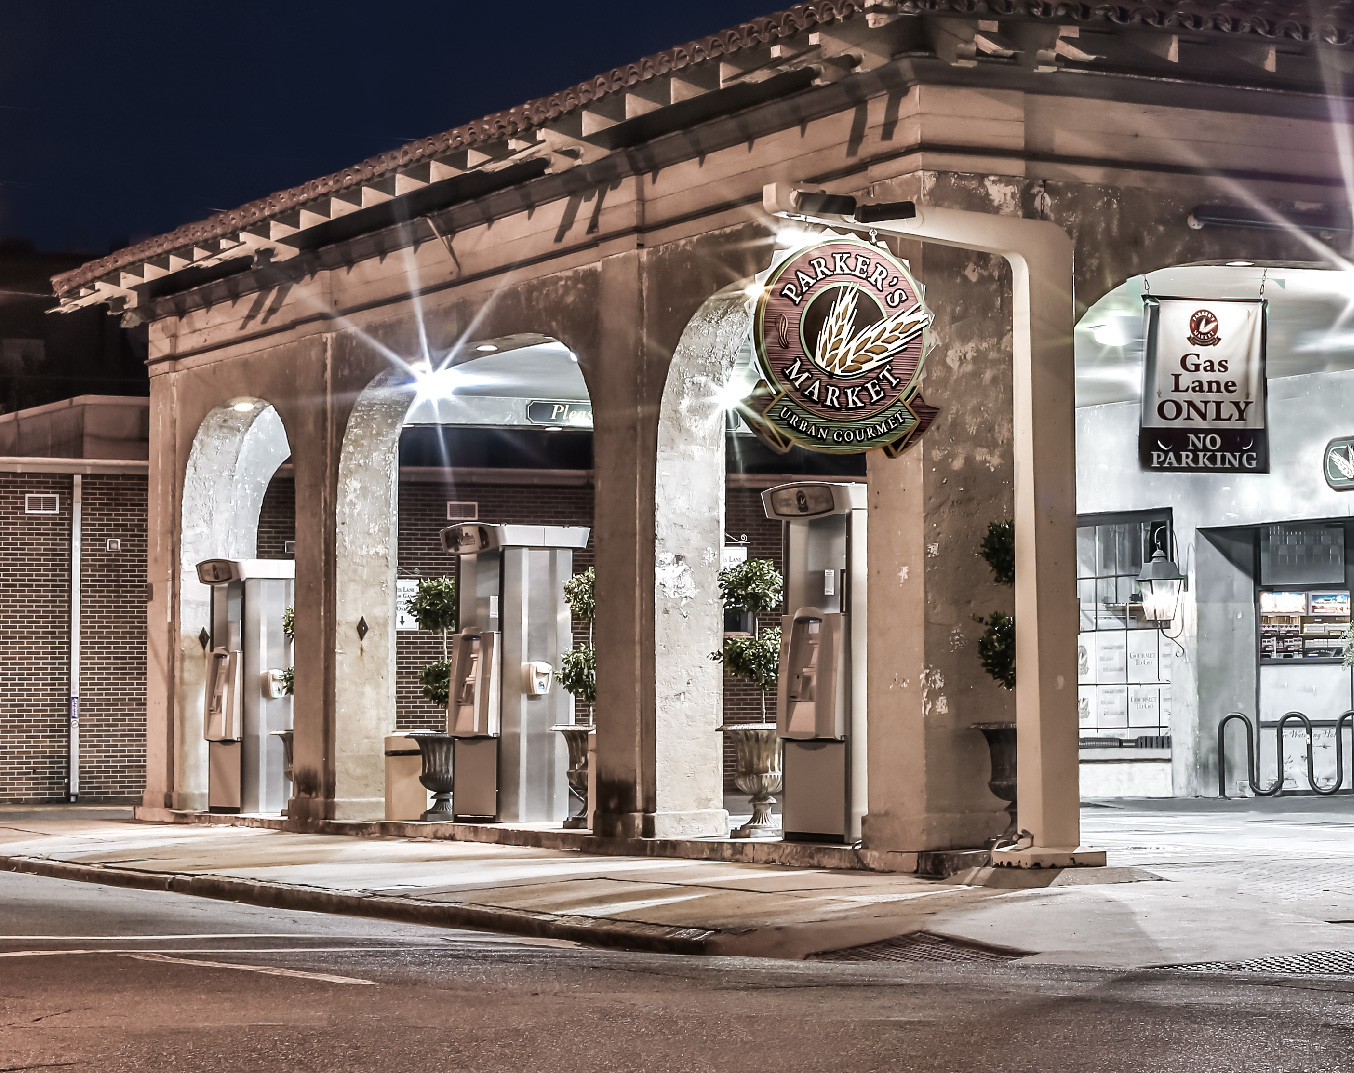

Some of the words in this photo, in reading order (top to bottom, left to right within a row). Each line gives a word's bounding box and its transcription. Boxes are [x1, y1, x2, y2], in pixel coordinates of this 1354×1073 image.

[782, 252, 908, 307] PARKER'S
[1179, 353, 1229, 373] Gas
[784, 358, 900, 408] MARKET
[1171, 373, 1237, 394] Lane
[550, 404, 593, 420] Pleas
[1157, 399, 1254, 422] ONLY
[780, 407, 829, 440] URBAN
[833, 411, 905, 442] GOURMET
[1187, 433, 1222, 450] NO
[1151, 451, 1257, 468] PARKING
